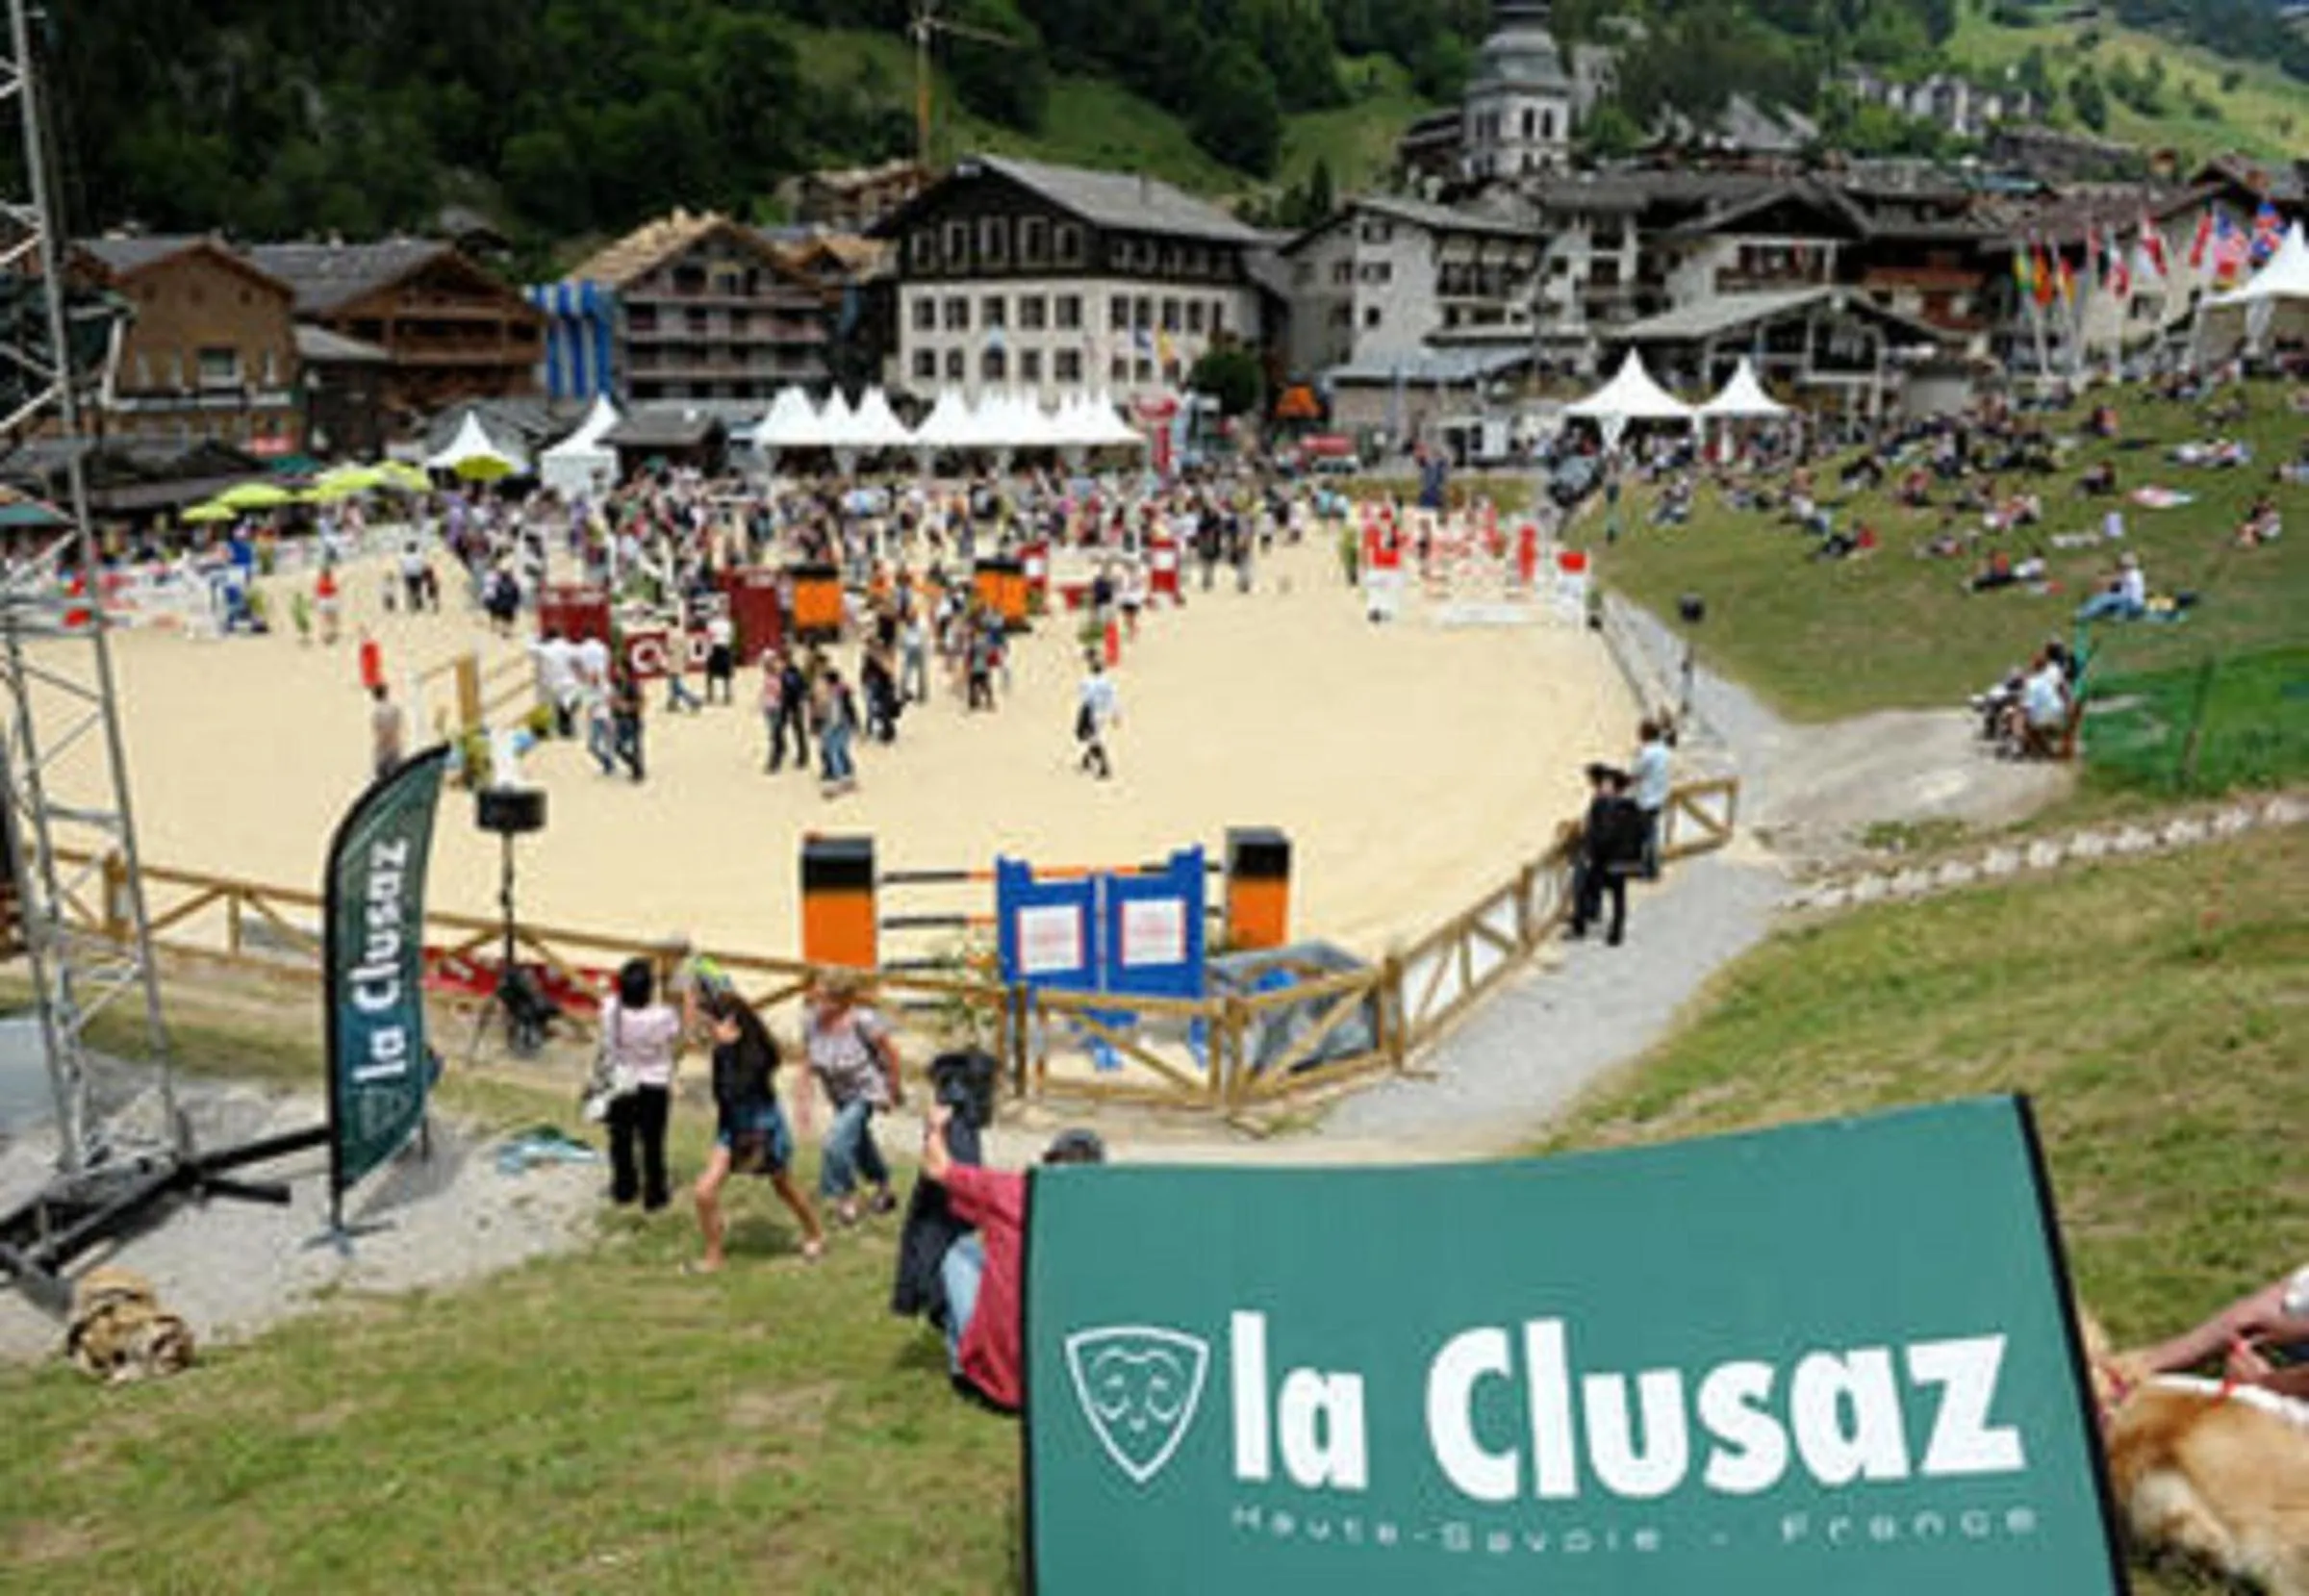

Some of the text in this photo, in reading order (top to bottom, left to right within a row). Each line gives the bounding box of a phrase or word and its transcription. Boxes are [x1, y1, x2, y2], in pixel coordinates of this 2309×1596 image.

[347, 837, 410, 1082] la Clusaz
[1231, 1309, 2026, 1503] la Clusaz
